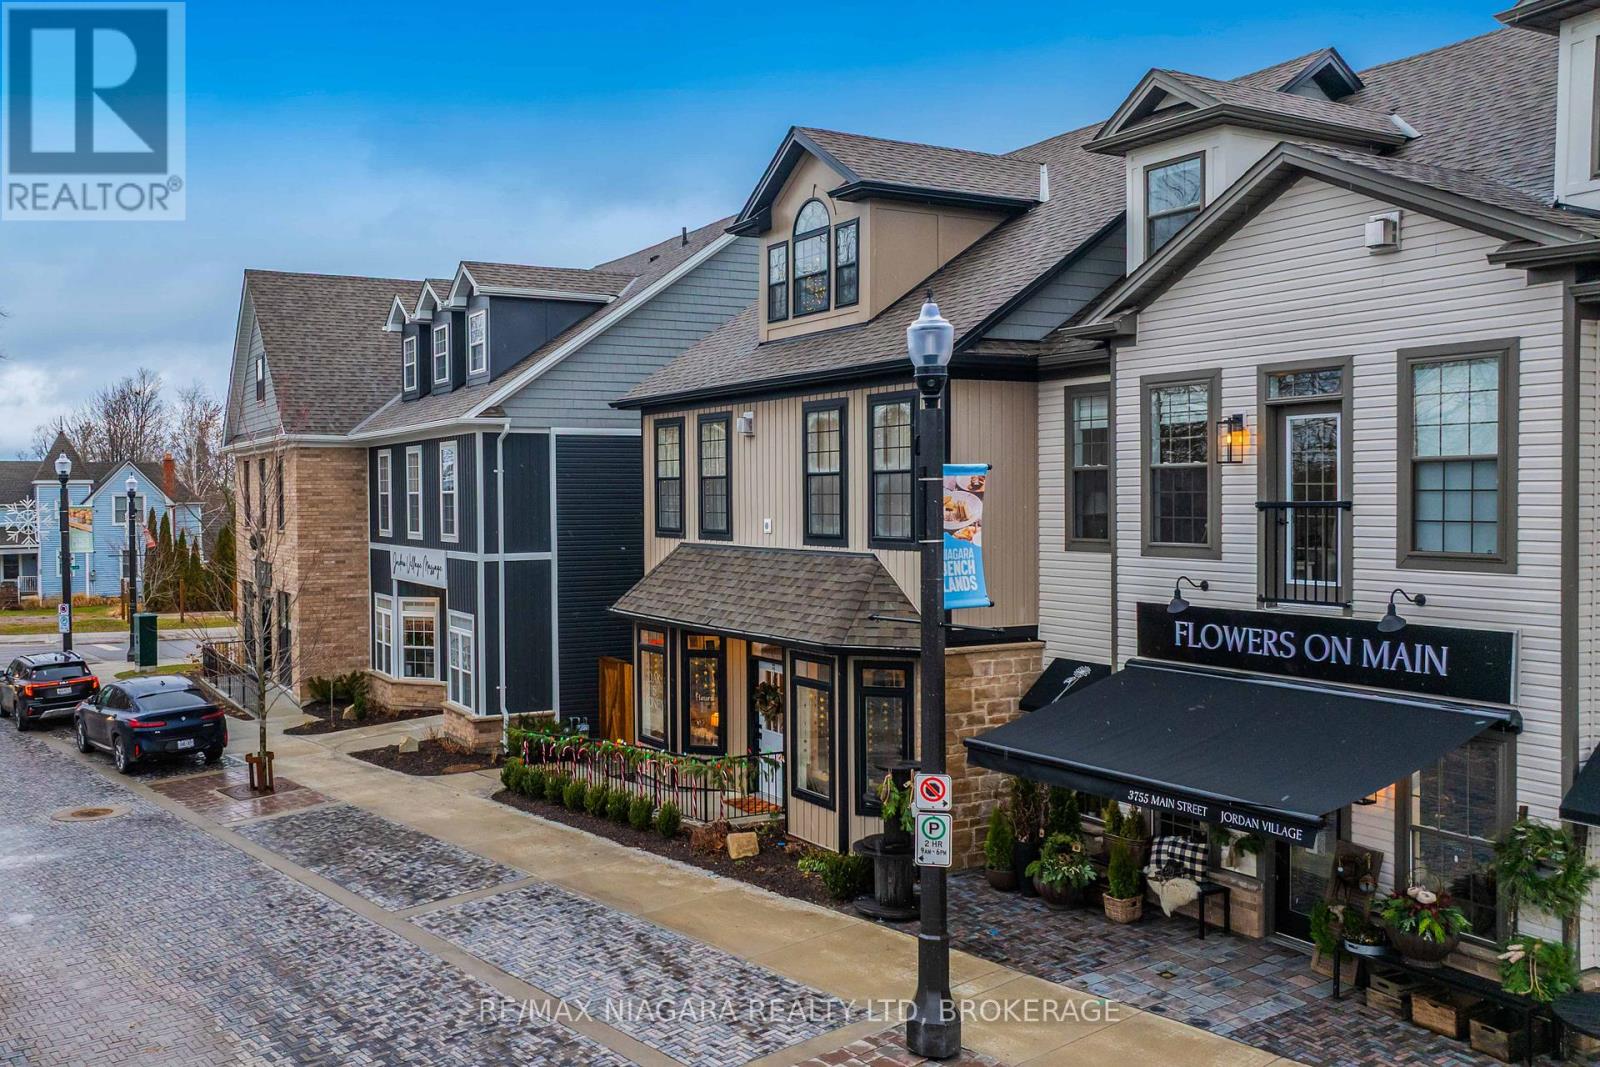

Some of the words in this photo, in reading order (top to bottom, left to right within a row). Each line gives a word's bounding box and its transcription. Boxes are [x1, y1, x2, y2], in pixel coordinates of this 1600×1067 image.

[1174, 620, 1297, 659] FLOWERS
[1303, 633, 1353, 666] ON
[1361, 638, 1449, 677] MAIN
[929, 822, 939, 834] P
[1126, 789, 1150, 805] 3755
[1150, 794, 1176, 810] MAIN
[1176, 799, 1209, 818] STREET
[1219, 810, 1260, 831] JORDAN
[1261, 820, 1303, 842] VILLAGE
